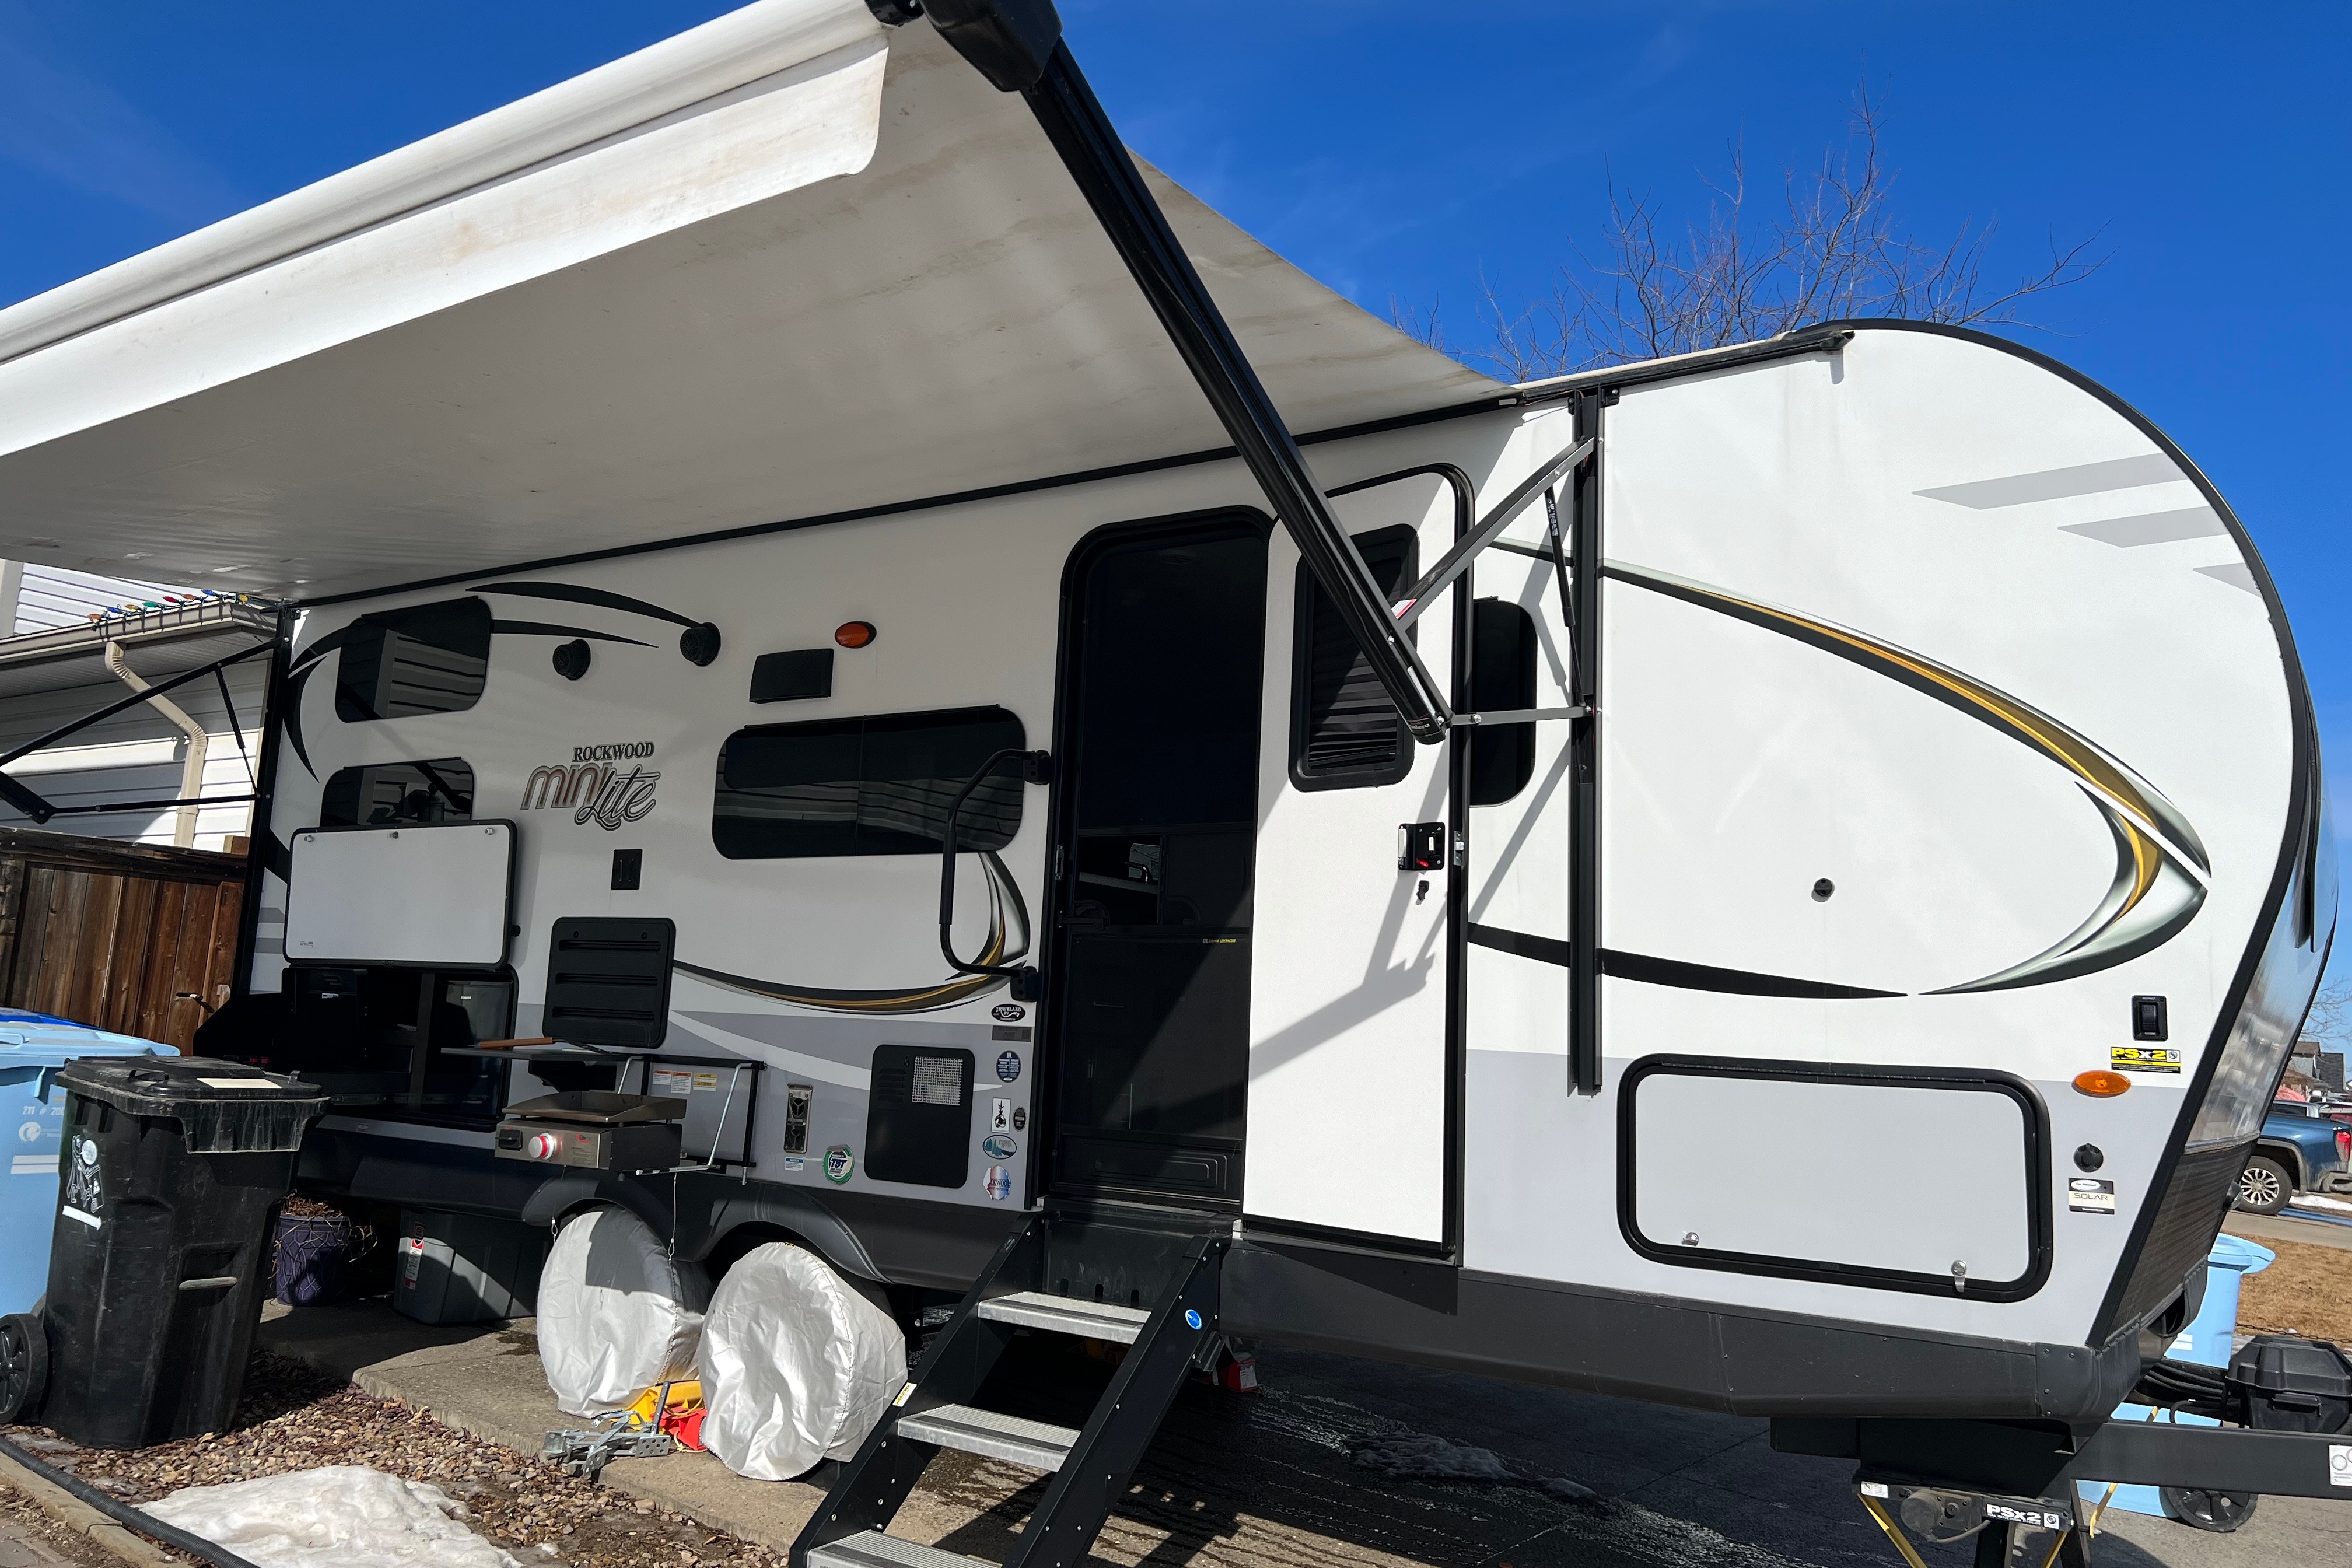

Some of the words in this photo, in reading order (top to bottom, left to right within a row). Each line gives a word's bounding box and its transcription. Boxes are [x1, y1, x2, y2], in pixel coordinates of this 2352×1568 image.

[572, 741, 655, 762] ROCKWOOD
[575, 764, 661, 831] Lite
[2112, 1048, 2166, 1060] PSx2
[831, 1158, 848, 1168] TST
[1986, 1504, 2041, 1523] PSx2
